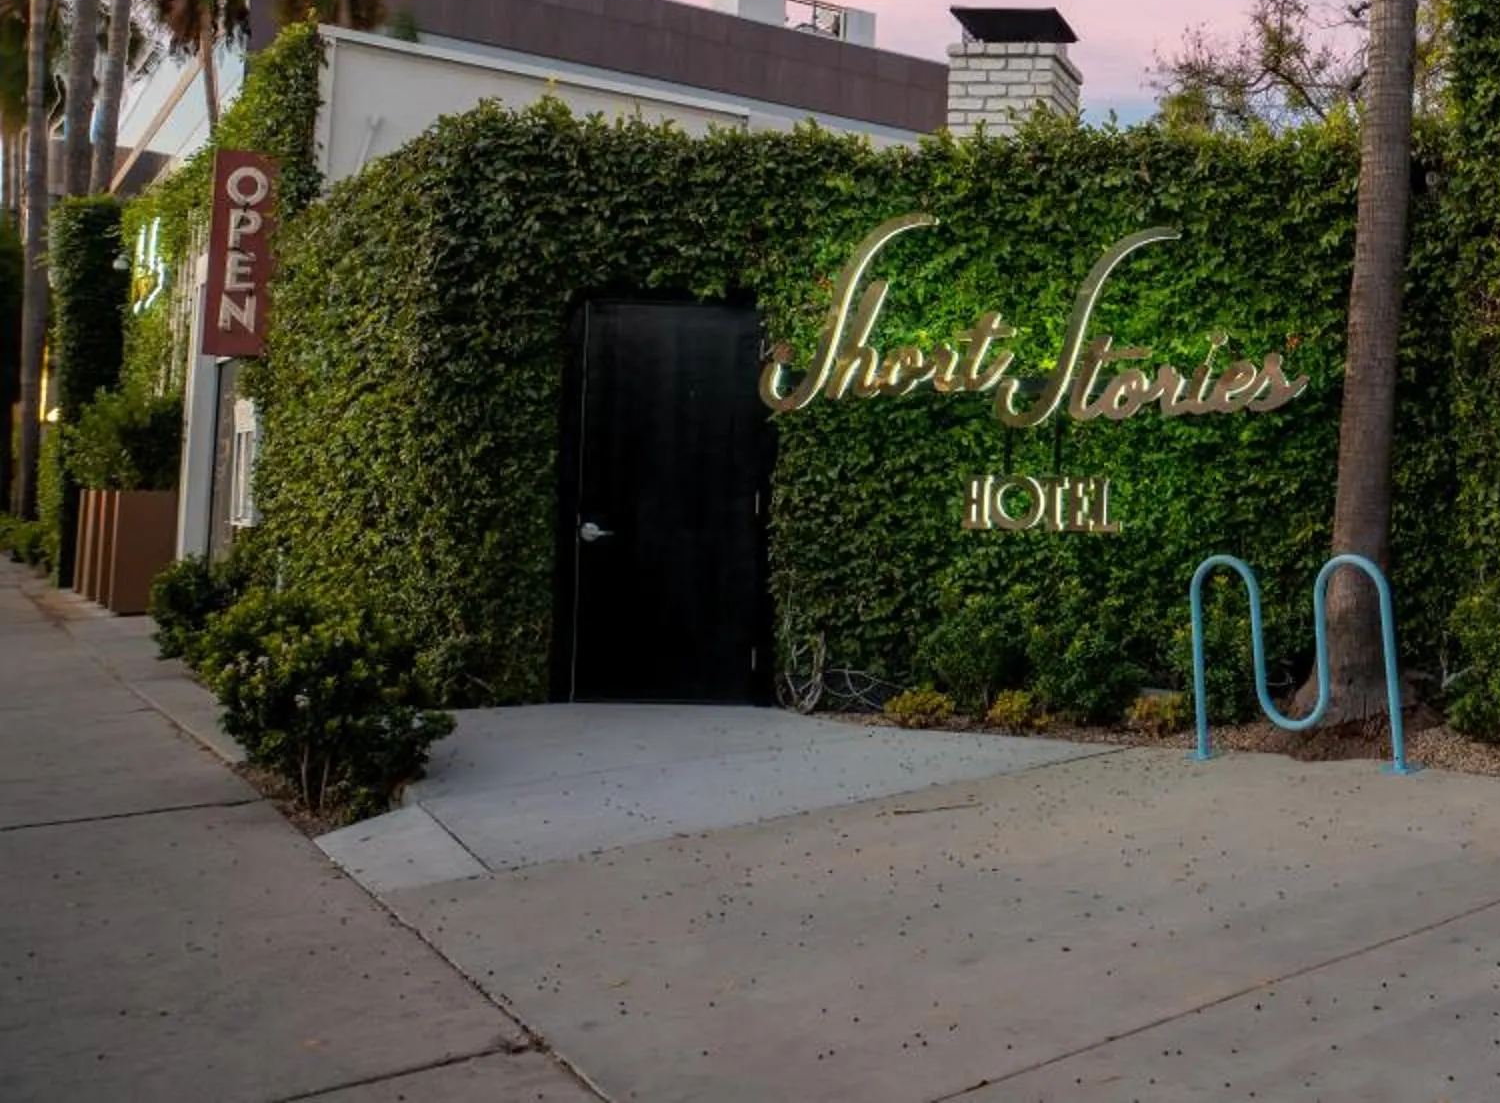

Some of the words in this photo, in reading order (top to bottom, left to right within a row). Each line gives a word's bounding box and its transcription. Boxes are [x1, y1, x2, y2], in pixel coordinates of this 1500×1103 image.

[218, 166, 270, 334] OPEN
[759, 213, 1016, 411] Short
[994, 227, 1308, 427] Stories
[962, 474, 1123, 532] HOTEL
